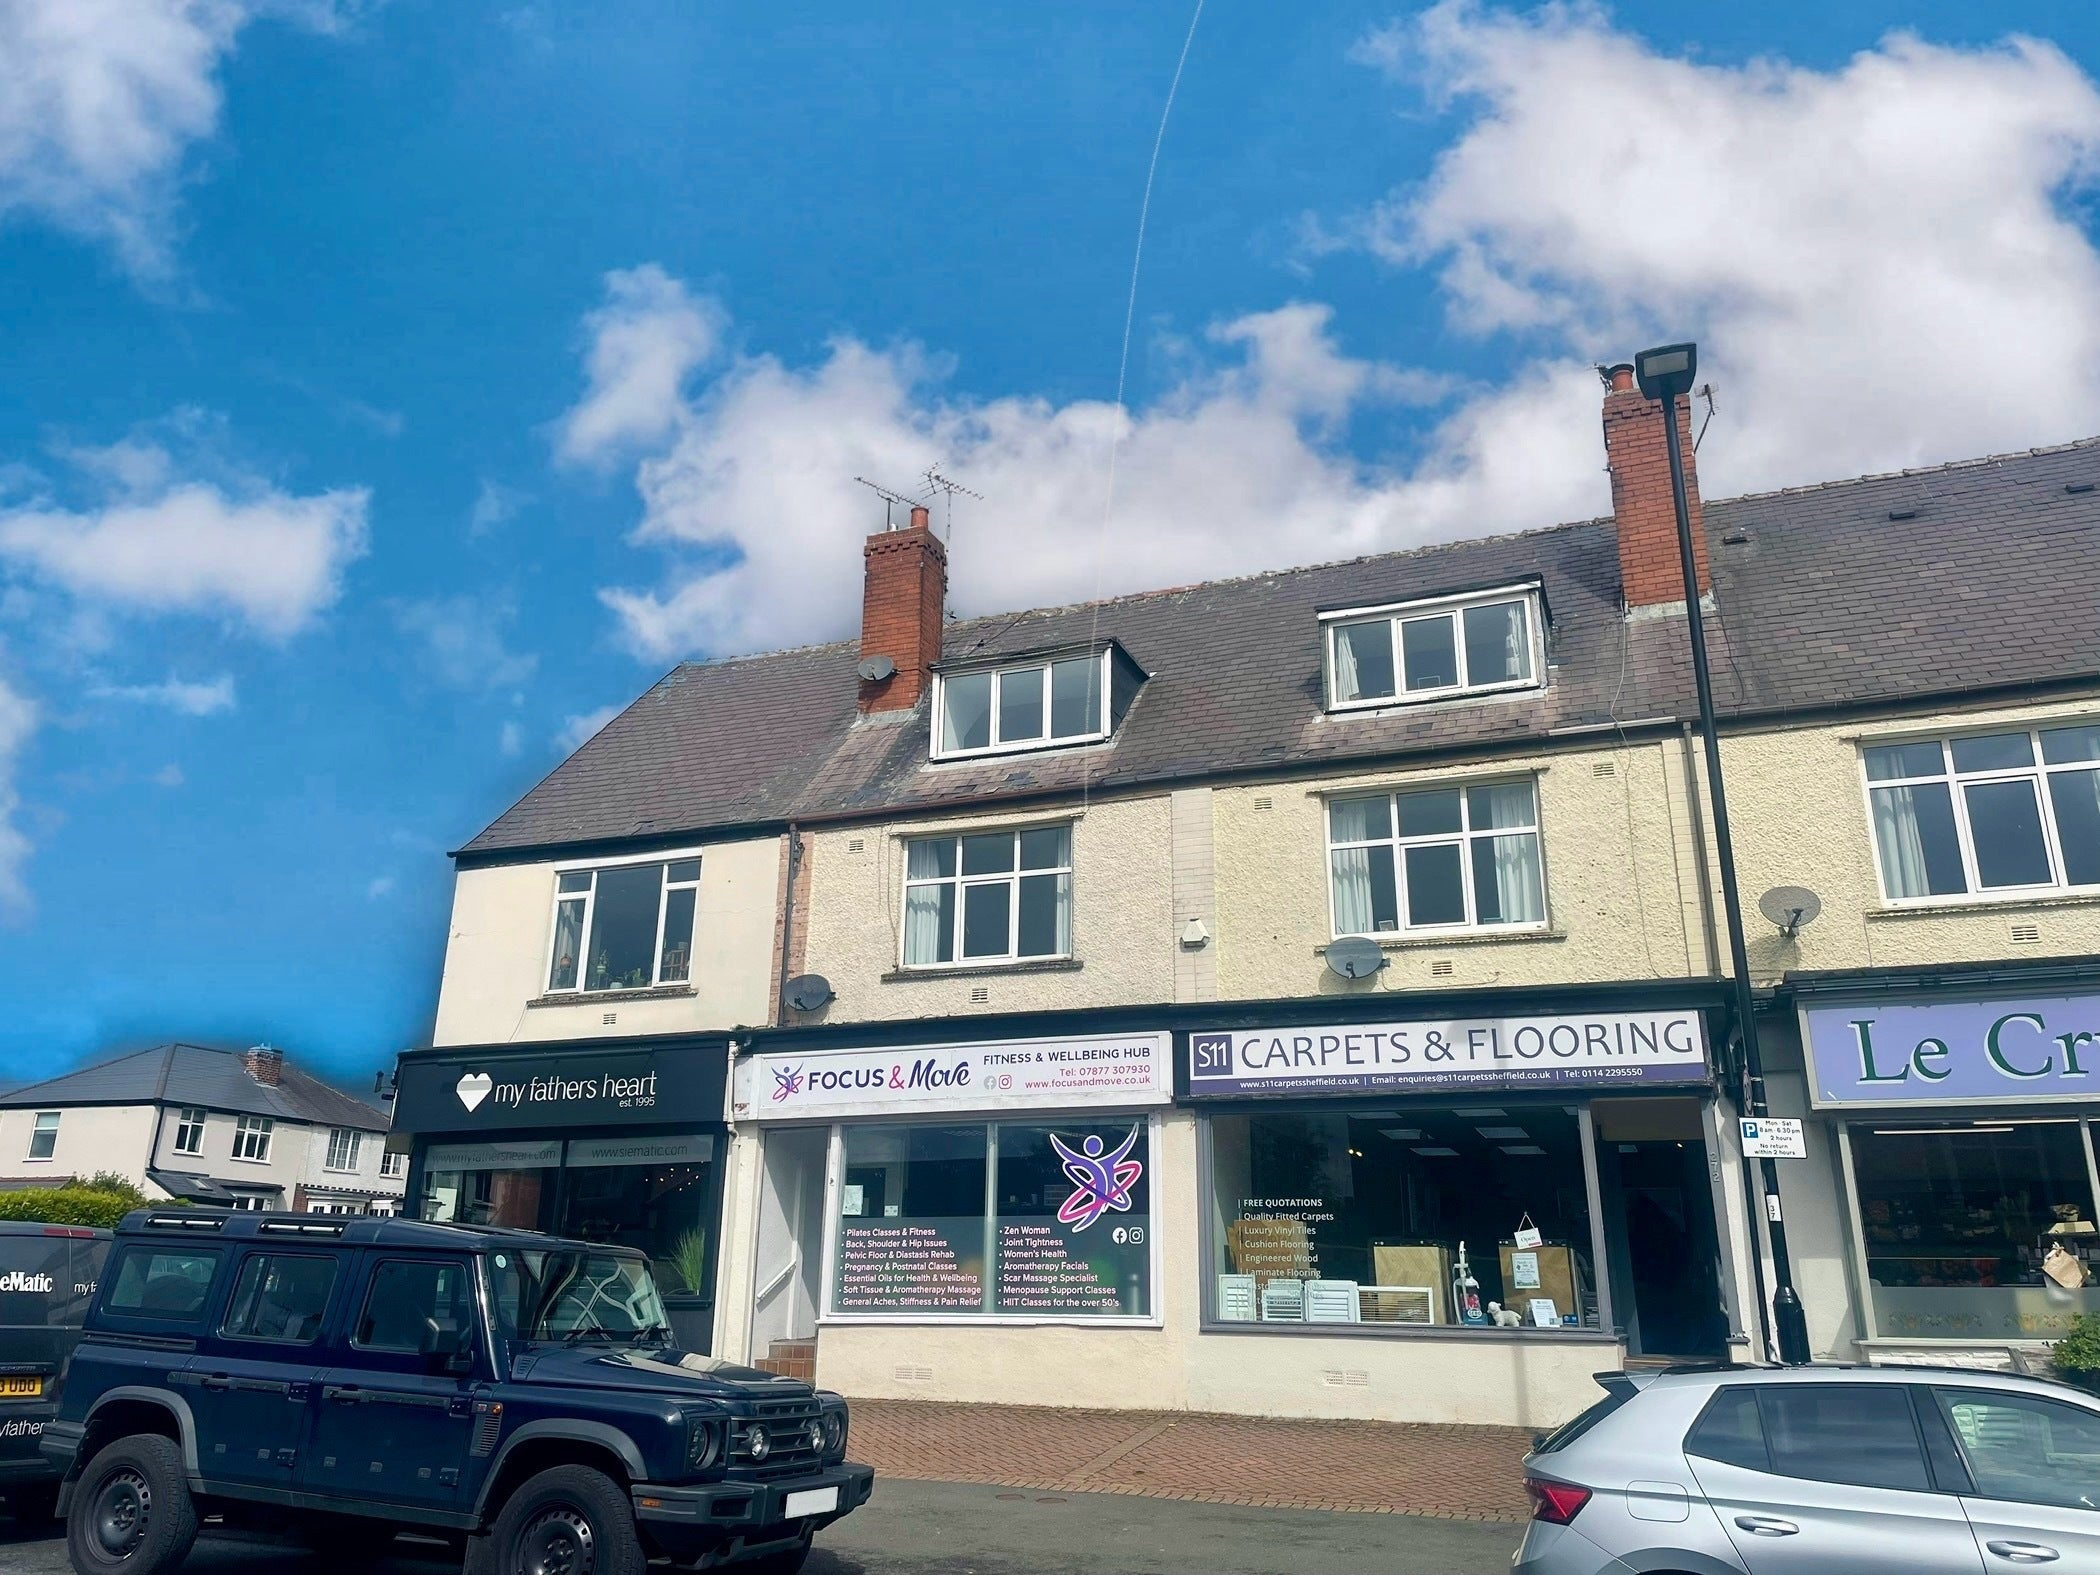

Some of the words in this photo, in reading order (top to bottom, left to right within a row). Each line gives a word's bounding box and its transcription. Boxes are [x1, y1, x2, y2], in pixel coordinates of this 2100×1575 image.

[1198, 1042, 1227, 1068] S11
[1241, 1032, 1411, 1068] CARPETS
[1425, 1030, 1454, 1060] &
[1468, 1020, 1694, 1059] FLOORING
[1848, 1020, 1952, 1085] Le
[1983, 1013, 2100, 1080] Cr
[984, 1053, 1031, 1065] FITNESS
[1036, 1053, 1043, 1062] &
[1048, 1049, 1119, 1061] WELLBEING
[1124, 1048, 1150, 1058] HUB
[808, 1068, 884, 1090] FOCUS
[889, 1065, 904, 1090] &
[908, 1058, 971, 1090] Move
[1079, 1067, 1109, 1075] 07877
[1112, 1065, 1150, 1074] 307930
[1025, 1075, 1150, 1088] www.focusandmove.co.uk
[1240, 1078, 1359, 1088] www.s11carpetssheffield.co.uk
[1398, 1071, 1550, 1084] enquiries@s11carpetssheffield.co.uk
[1564, 1069, 1580, 1078] Tel:
[1582, 1069, 1603, 1078] 0114
[1605, 1068, 1642, 1077] 2295550
[495, 1082, 526, 1108] my
[529, 1077, 597, 1102] fathers
[602, 1070, 656, 1098] heart
[636, 1097, 655, 1106] 1995
[1266, 1199, 1322, 1208] QUOTATIONS
[1244, 1213, 1273, 1222] Quality
[1302, 1213, 1334, 1222] Carpets
[1244, 1227, 1272, 1236] Luxury
[1274, 1226, 1294, 1236] Vinyl
[909, 1240, 922, 1248] Hip
[1025, 1238, 1063, 1247] Tightness
[1280, 1240, 1314, 1250] Flooring
[1246, 1254, 1291, 1264] Engineered
[845, 1263, 883, 1272] Pregnancy
[1003, 1262, 1059, 1271] Aromatherapy
[1287, 1268, 1321, 1278] Flooring
[940, 1274, 977, 1283] Wellbeing
[1023, 1274, 1058, 1283] Massage
[1060, 1274, 1098, 1283] Specialist
[75, 1284, 89, 1295] my
[893, 1286, 945, 1294] Aromatherapy
[947, 1286, 981, 1294] Massage
[1003, 1286, 1048, 1296] Menopause
[1051, 1286, 1082, 1296] Support
[873, 1298, 898, 1306] Aches,
